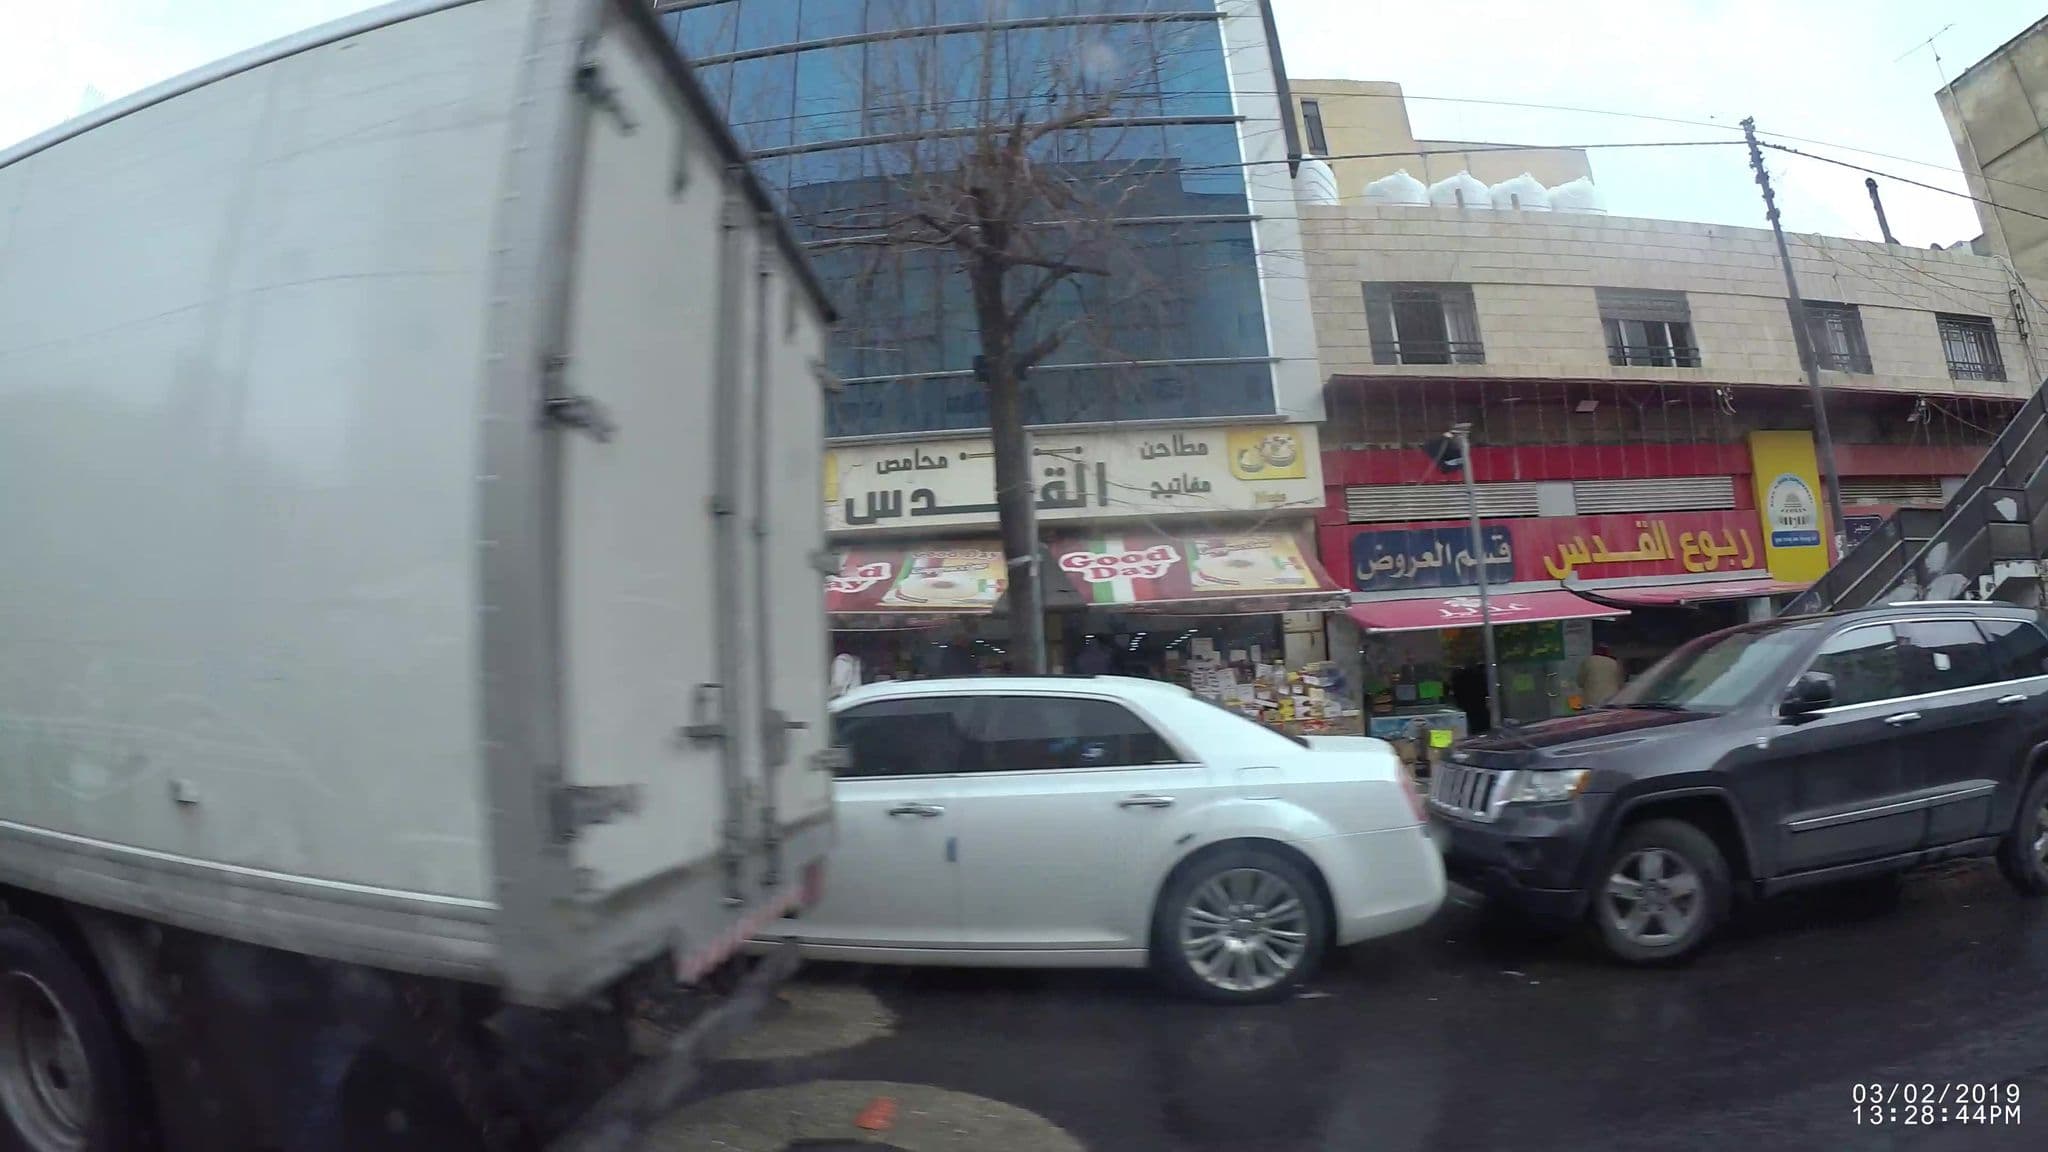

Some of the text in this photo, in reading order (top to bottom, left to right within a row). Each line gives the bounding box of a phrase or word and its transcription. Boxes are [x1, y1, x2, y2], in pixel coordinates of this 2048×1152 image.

[1140, 432, 1208, 460] مطاحن
[876, 448, 948, 475] محامص
[845, 461, 1107, 525] القدس
[1063, 548, 1172, 569] Good
[1357, 540, 1451, 581] العروض
[1544, 519, 1755, 580] ربوع القدس
[1091, 563, 1163, 580] Day
